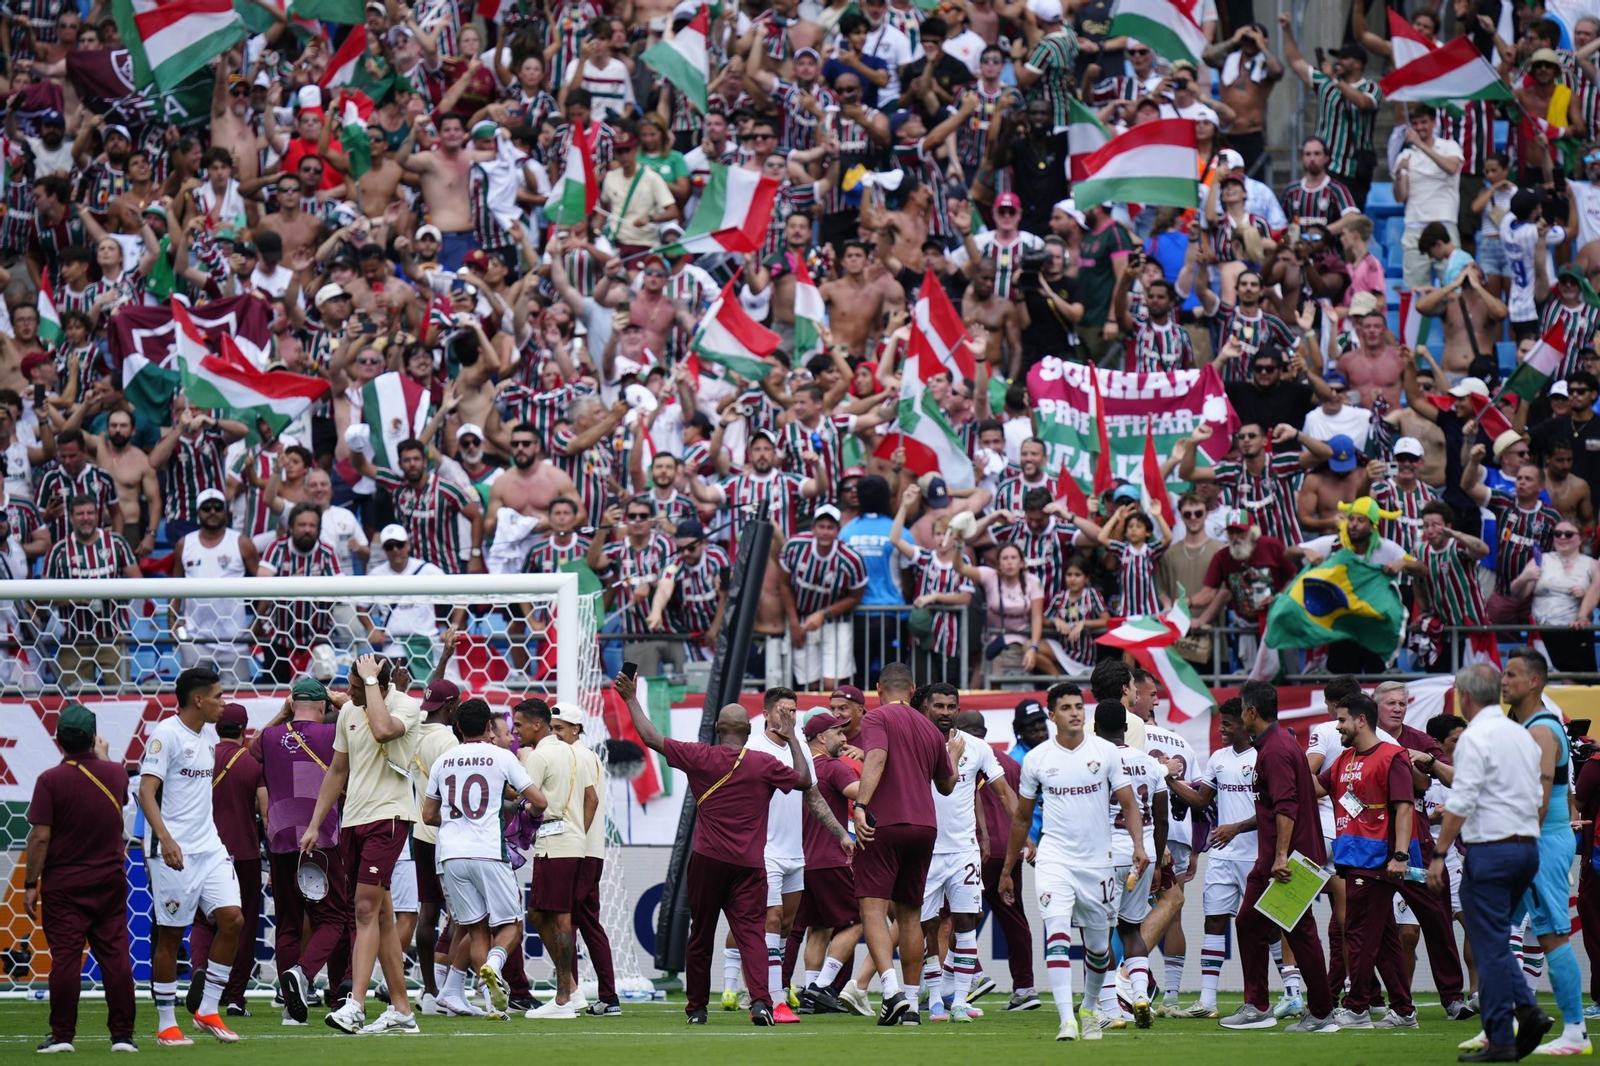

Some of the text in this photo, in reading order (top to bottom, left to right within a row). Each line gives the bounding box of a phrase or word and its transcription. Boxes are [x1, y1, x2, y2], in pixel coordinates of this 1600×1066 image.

[1147, 733, 1185, 748] FREYTES
[443, 757, 494, 768] PH GANSO
[1127, 765, 1147, 776] RIAS
[1049, 782, 1102, 796] SUPERBET
[1218, 784, 1253, 793] UPERBET
[445, 773, 489, 820] 10
[964, 863, 981, 885] 29
[1100, 877, 1115, 904] 12
